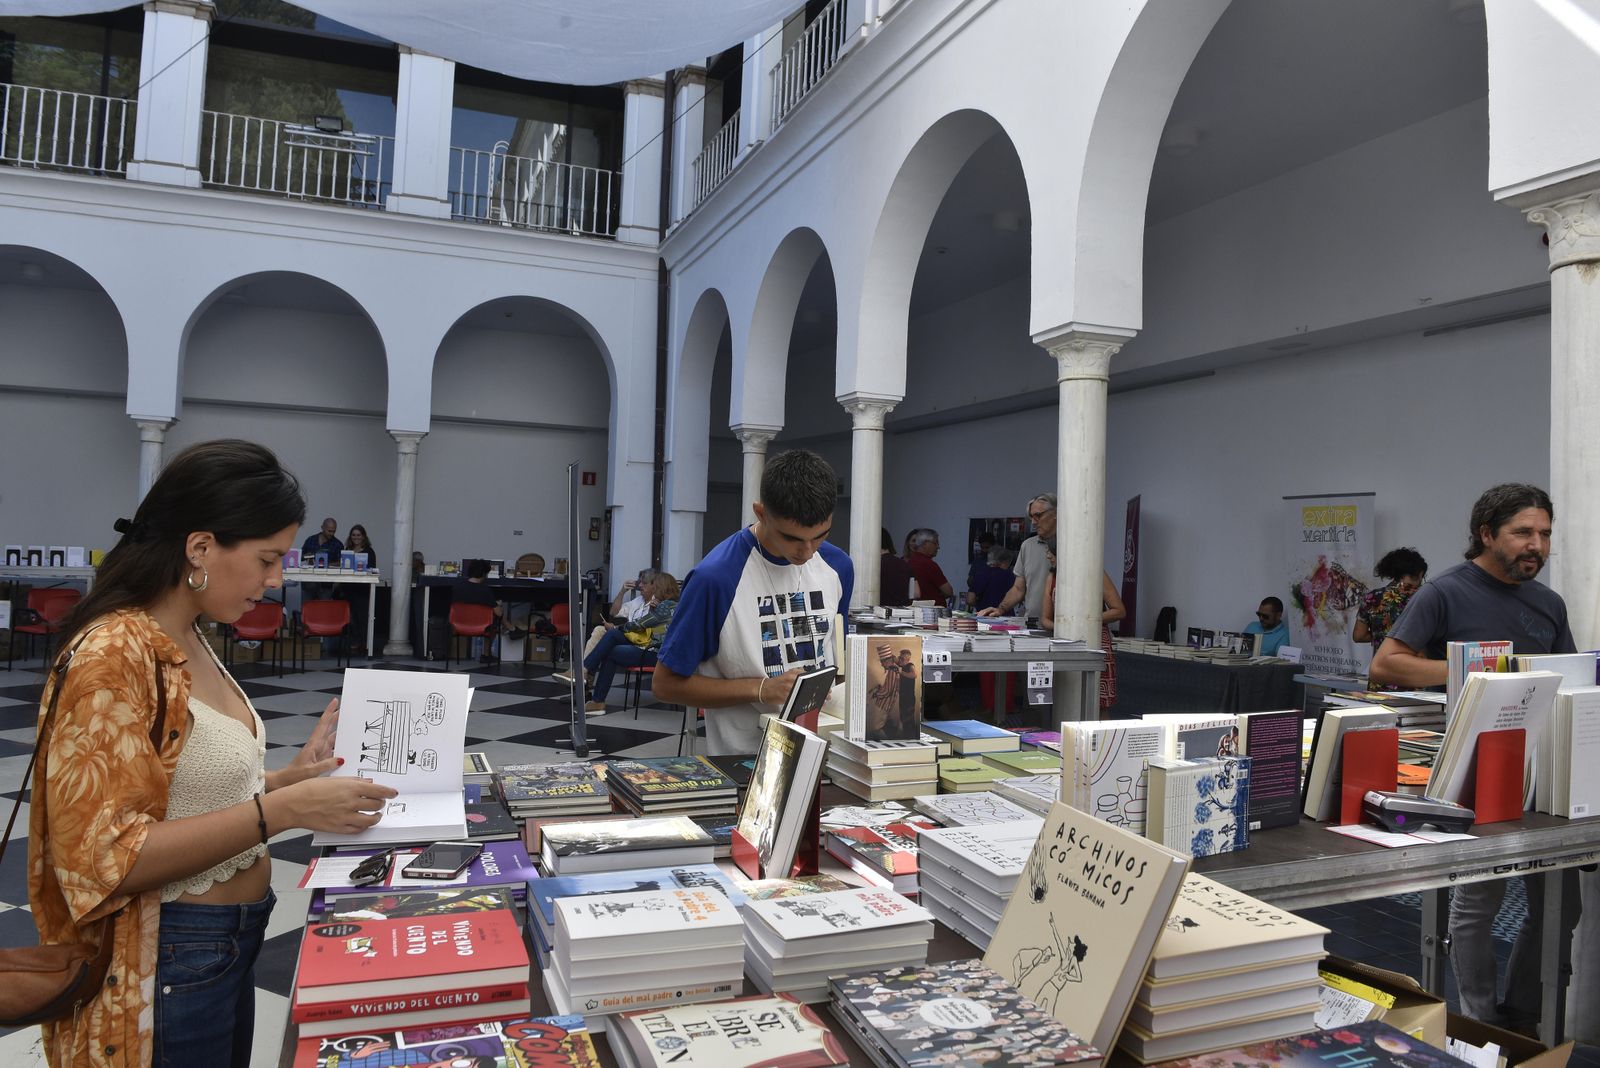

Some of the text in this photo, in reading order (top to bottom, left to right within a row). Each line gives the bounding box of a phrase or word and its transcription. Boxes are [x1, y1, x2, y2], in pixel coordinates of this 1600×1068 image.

[1201, 718, 1238, 729] FELICES
[406, 925, 427, 955] CUENTO
[431, 930, 448, 945] DEL
[411, 998, 430, 1008] DEL
[435, 992, 480, 1006] CUENTO
[653, 991, 673, 1001] padre
[749, 1011, 785, 1033] SE
